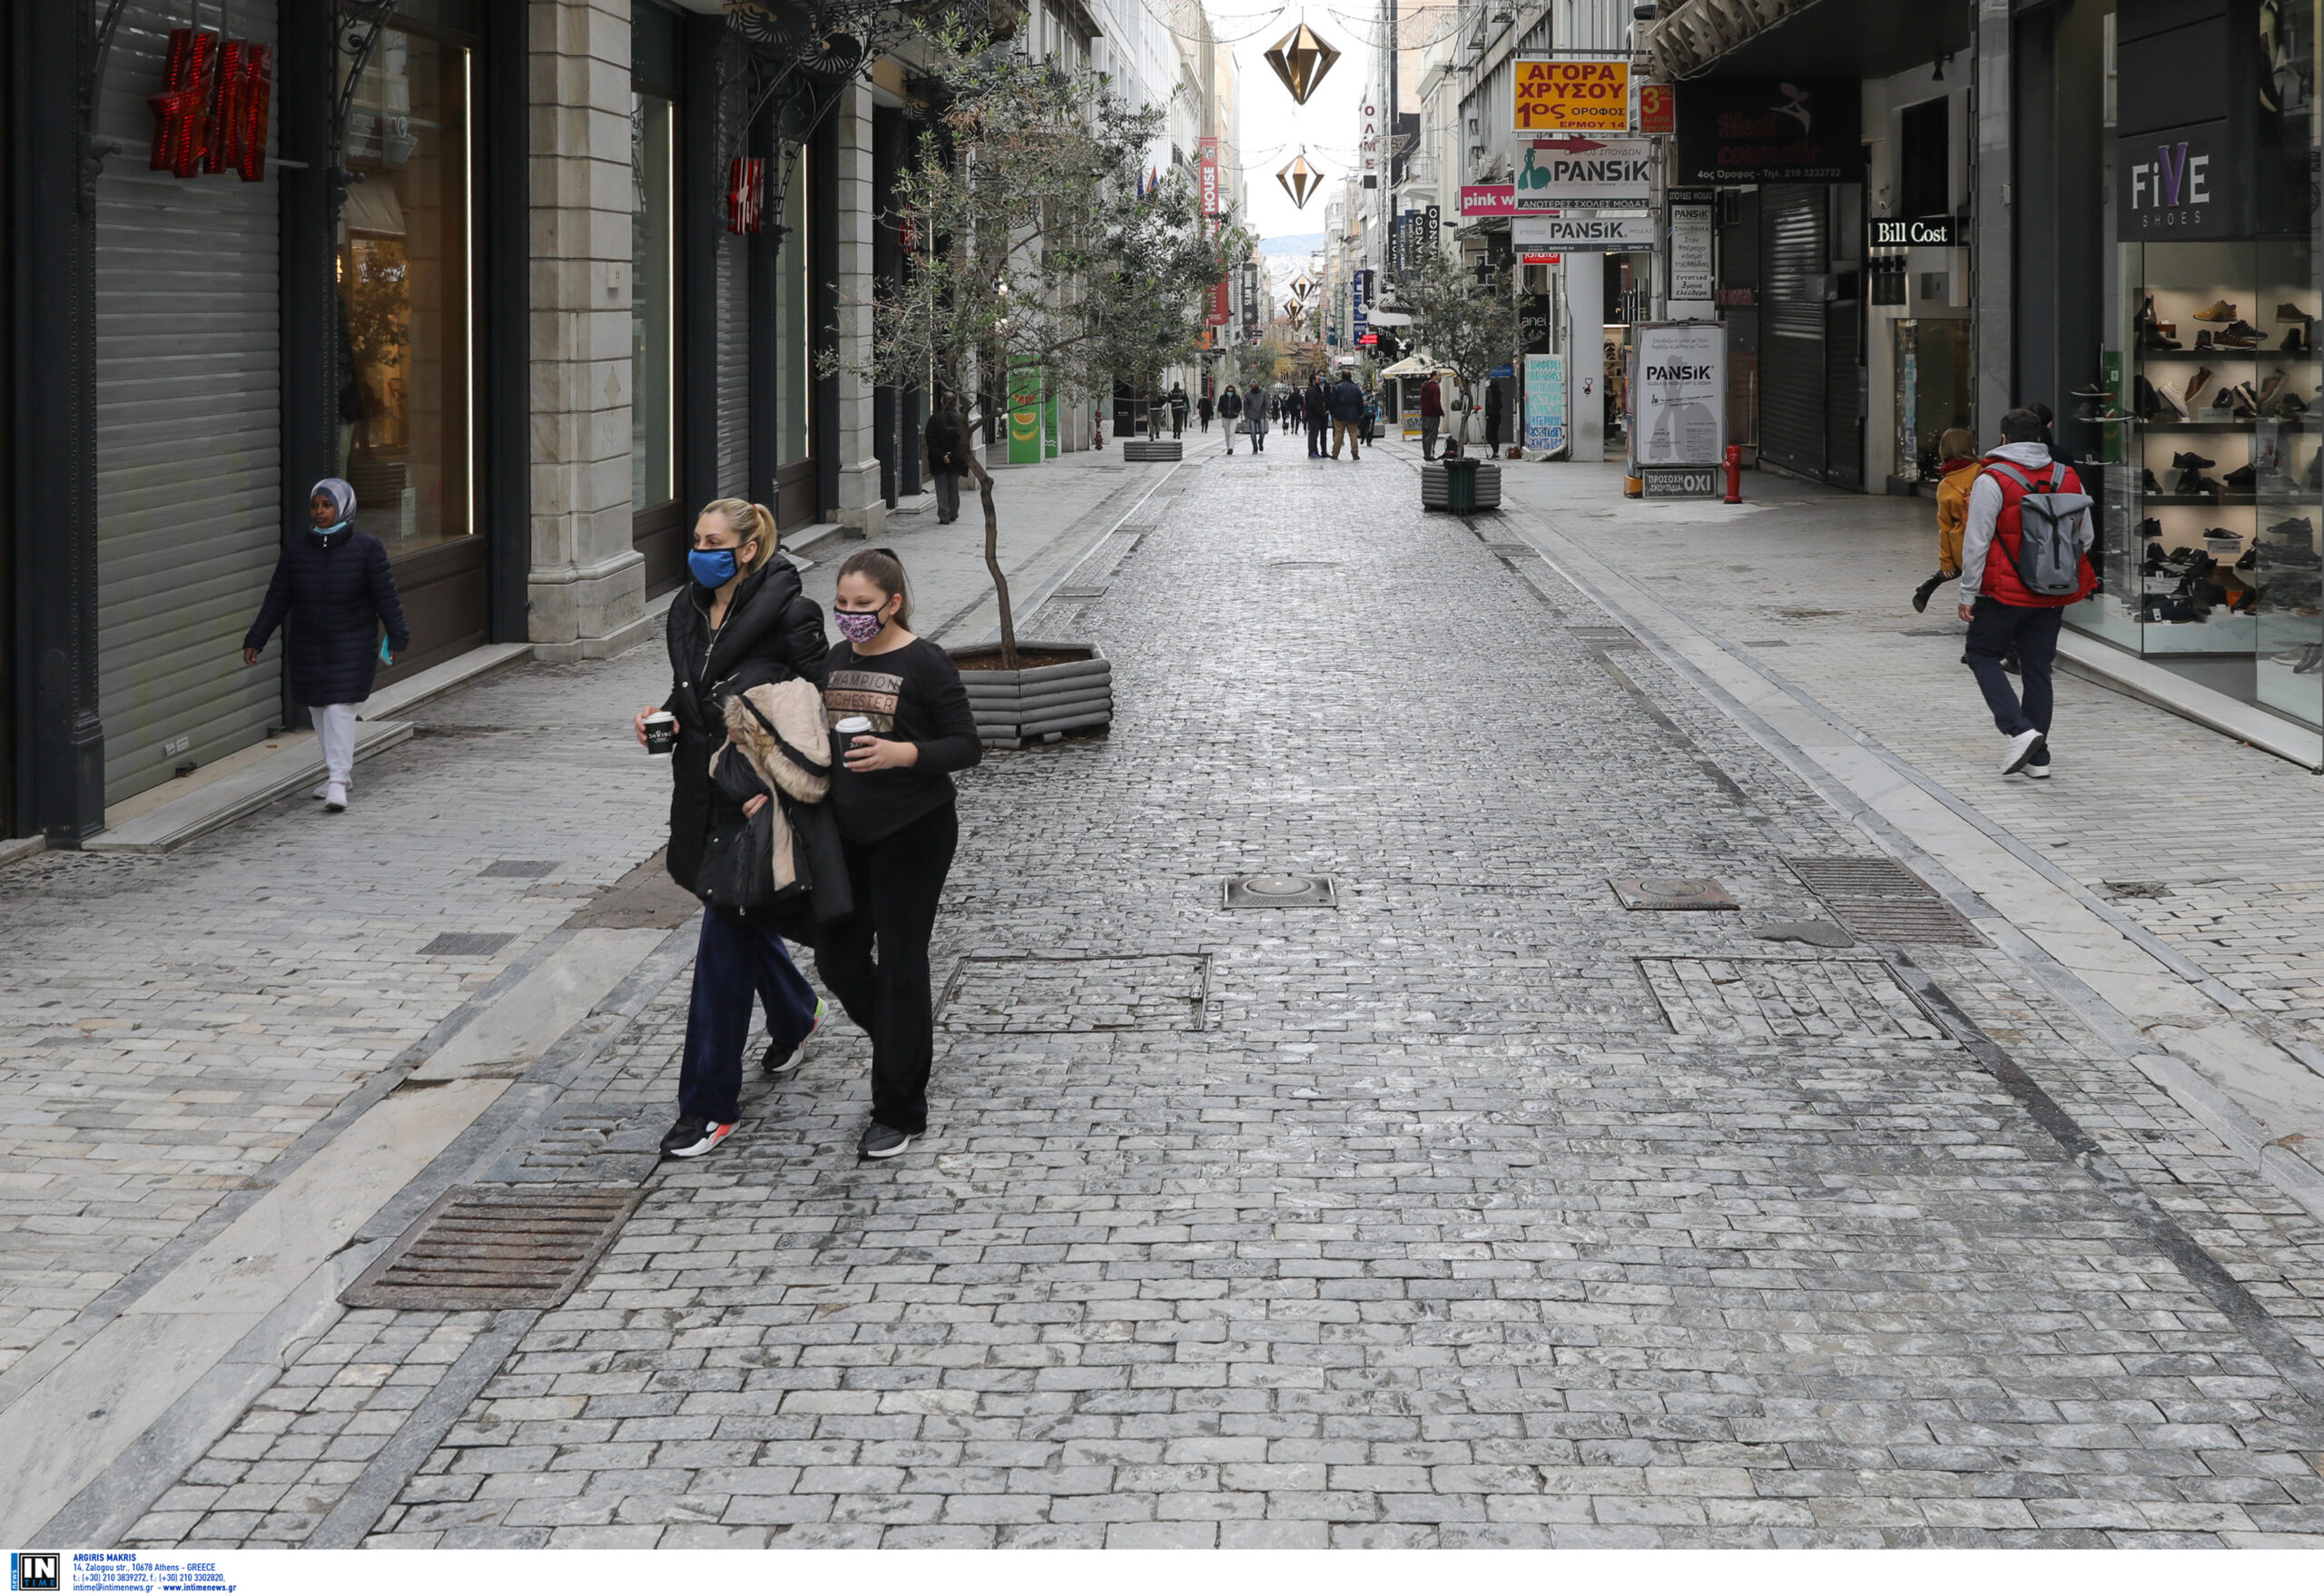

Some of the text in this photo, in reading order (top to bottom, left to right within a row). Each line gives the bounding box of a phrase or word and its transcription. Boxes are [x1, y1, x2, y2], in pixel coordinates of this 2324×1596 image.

[1528, 64, 1616, 80] ΑΓΟΡΑ
[1518, 83, 1624, 99] ΧΡΥΣΟΥ
[1518, 103, 1625, 128] 1ος ΟΡΟΦΟΣ
[1599, 148, 1641, 156] ΣΠΟΥΔΩΝ
[1698, 170, 1714, 180] 4ος
[1717, 169, 1755, 180] Όροφος
[1785, 169, 1801, 178] 210
[1204, 166, 1216, 212] HOUSE
[1463, 192, 1497, 209] pink
[1522, 199, 1648, 209] ΑΝΩΤΕΡΕΣ ΣΧΟΛΕΣ ΜΟΔΑΣ
[2142, 211, 2201, 227] SHOES
[1429, 208, 1438, 261] MANGO
[1877, 222, 1947, 242] Bill Cost
[1415, 216, 1423, 265] MANGO
[1649, 475, 1683, 484] ΠΡΟΣΟΧΗ
[1684, 475, 1710, 491] ΟΧΙ
[825, 692, 893, 711] OCHESTER
